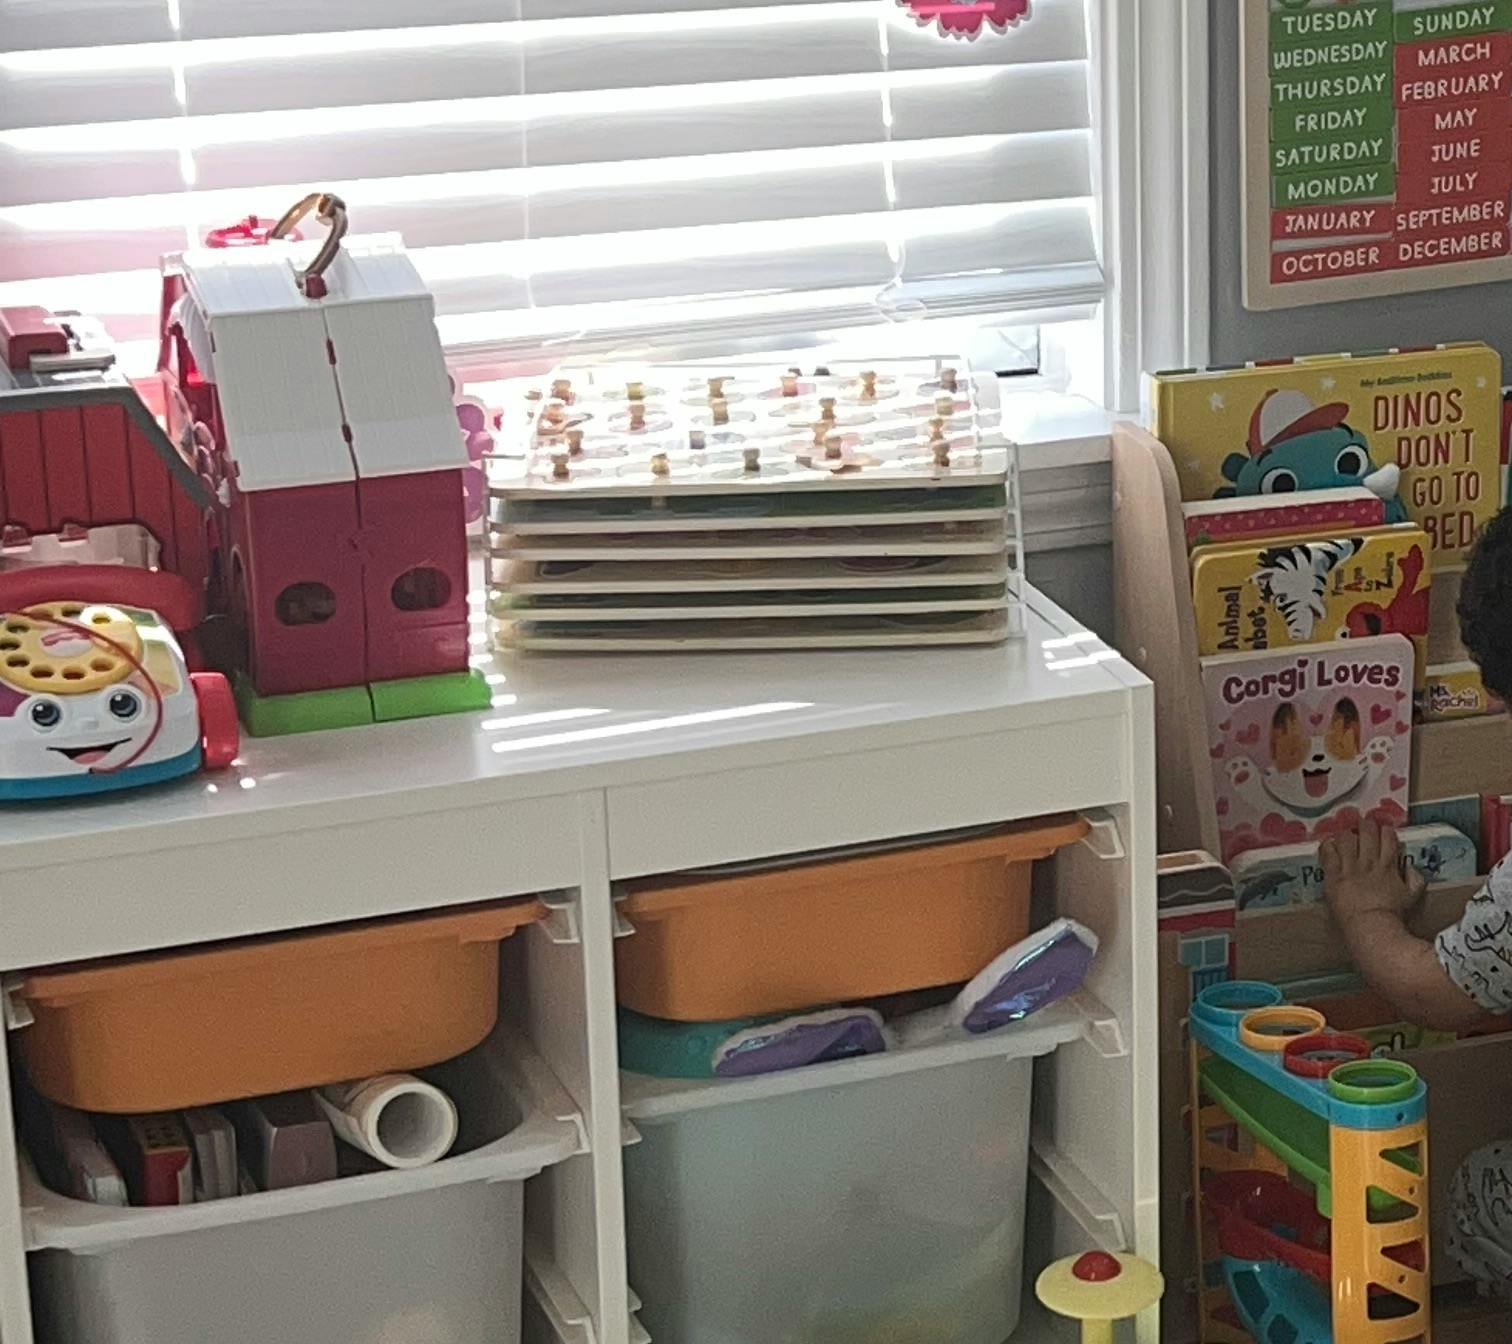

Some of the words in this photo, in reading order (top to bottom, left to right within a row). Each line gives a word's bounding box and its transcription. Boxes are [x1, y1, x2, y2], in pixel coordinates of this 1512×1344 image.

[1281, 7, 1378, 35] TUESDAY
[1412, 6, 1495, 36] SUNDAY
[1273, 40, 1388, 70] WEDNESDAY
[1417, 42, 1491, 67] MARCH
[1274, 72, 1387, 102] THURSDAY
[1401, 71, 1504, 103] FEBRUARY
[1294, 107, 1368, 133] FRIDAY
[1434, 107, 1478, 131] MAY
[1275, 138, 1384, 168] SATURDAY
[1430, 138, 1481, 163] JUNE
[1287, 172, 1379, 200] MONDAY
[1429, 171, 1479, 194] JULY
[1284, 209, 1377, 234] JANUARY
[1396, 200, 1505, 232] SEPTEMBER
[1281, 246, 1380, 276] OCTOBER
[1399, 230, 1503, 262] DECEMBER
[1373, 387, 1464, 433] DINOS
[1397, 427, 1475, 470] DON'T
[1412, 474, 1443, 507] GO
[1452, 470, 1481, 503] TO
[1423, 510, 1475, 551] BED
[1216, 584, 1243, 651] Animal
[1222, 658, 1307, 704] Corgi
[1316, 659, 1401, 688] Loves
